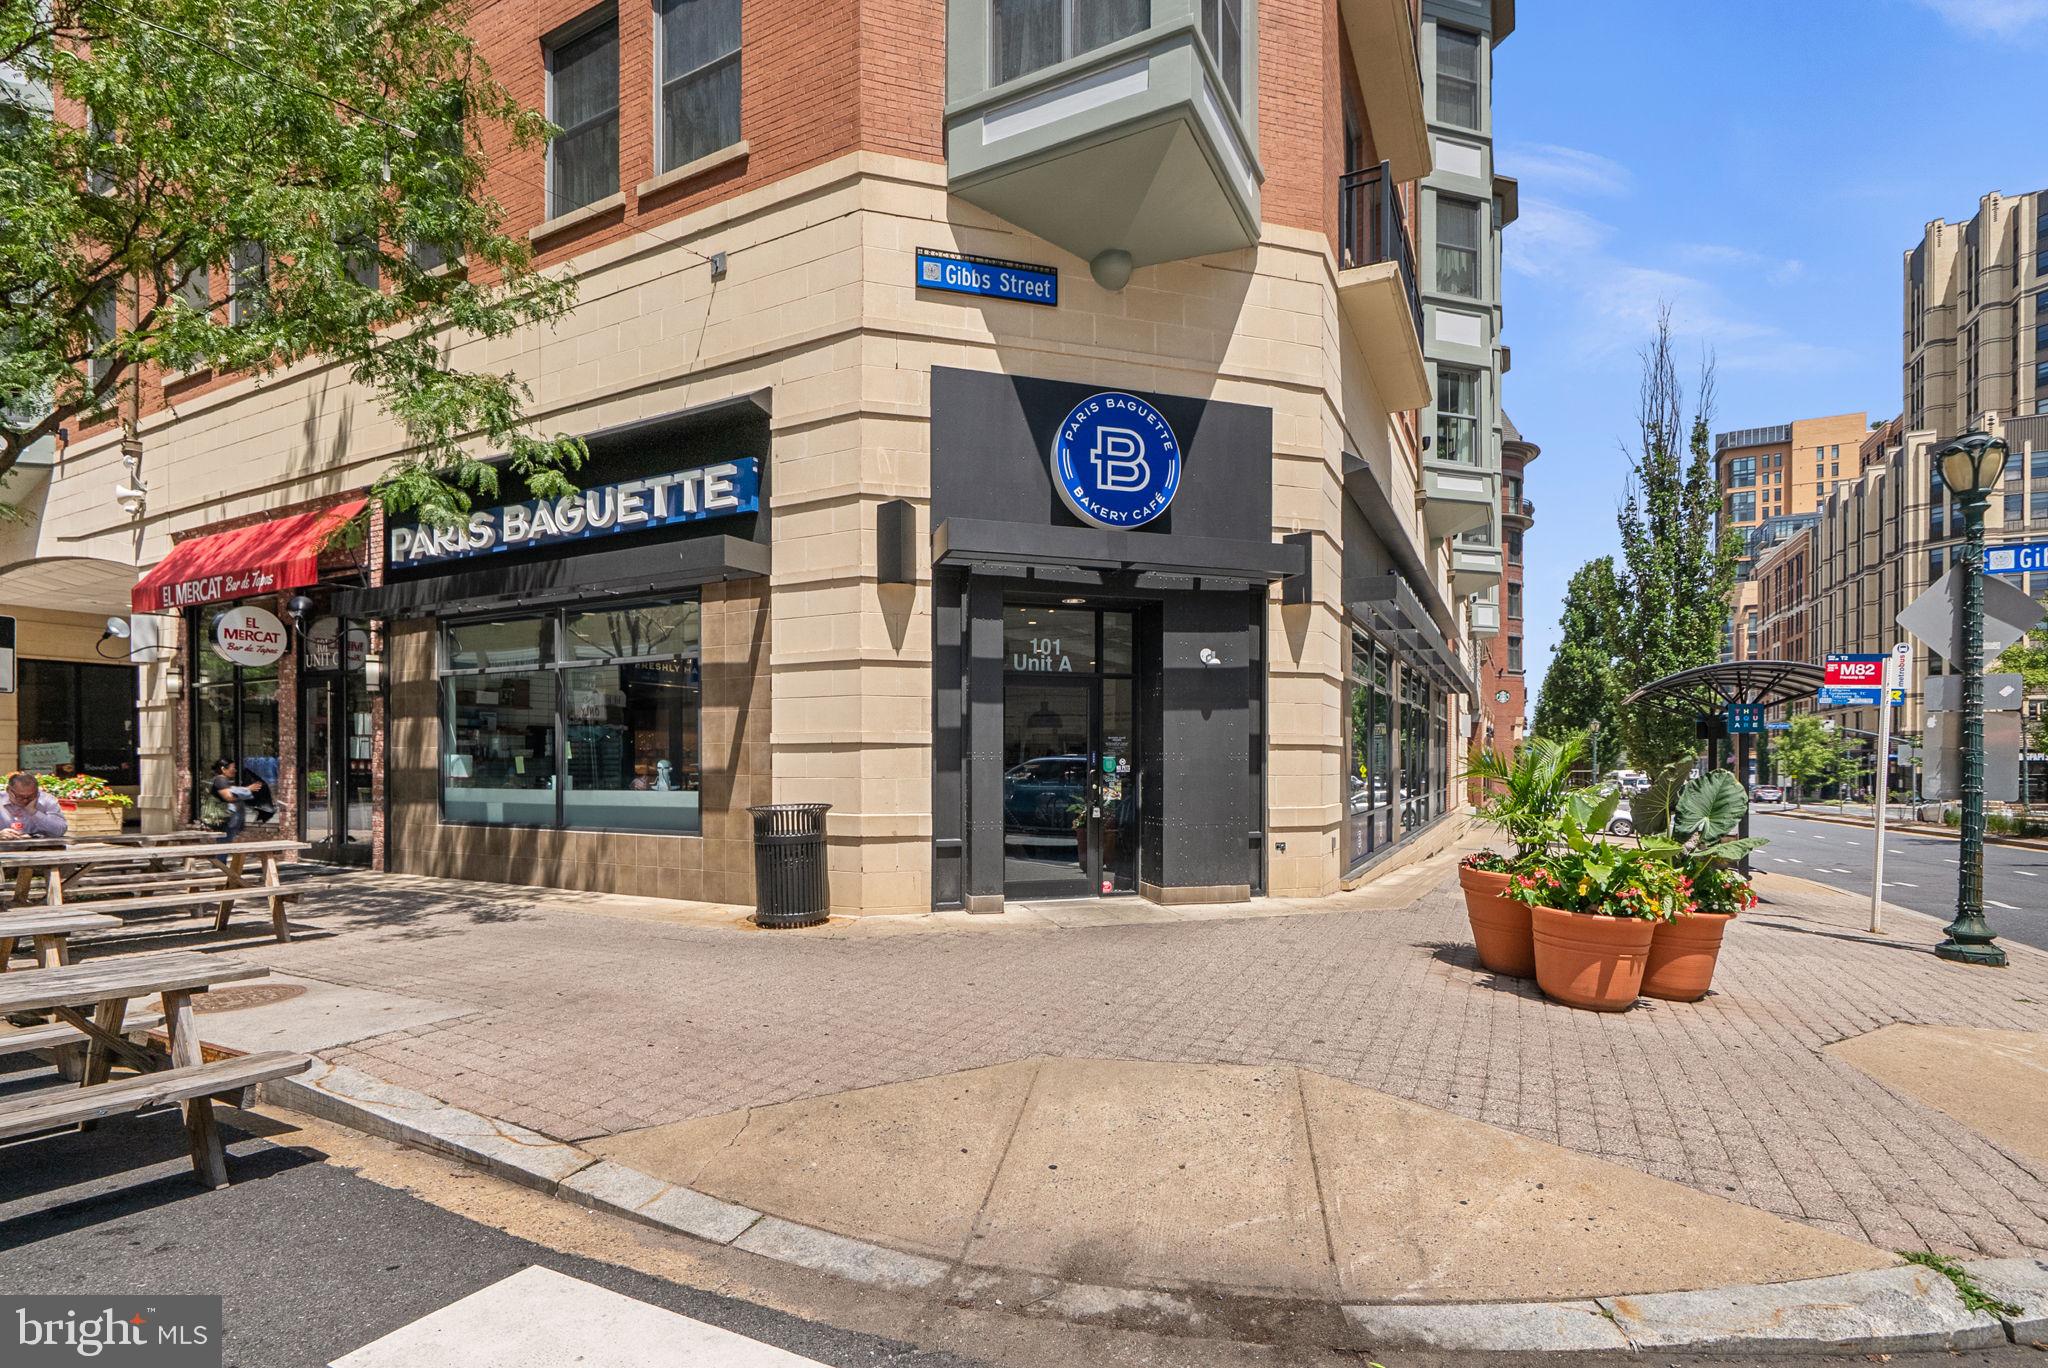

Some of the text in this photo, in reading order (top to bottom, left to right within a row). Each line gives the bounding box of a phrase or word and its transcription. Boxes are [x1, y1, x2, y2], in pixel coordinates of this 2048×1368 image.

[945, 264, 1051, 298] Gibbs Street
[1065, 398, 1173, 452] PARIS BAGUETTE
[391, 463, 739, 562] PARIS BAGUETTE
[1073, 486, 1165, 521] BAKERY CAFÉ
[162, 569, 274, 607] EL MERCAT Bar de Tapas
[245, 616, 259, 629] EL
[223, 628, 281, 644] MERCAT
[226, 642, 278, 656] Bar de Tapas
[1029, 638, 1060, 656] 101
[305, 652, 331, 668] UNIT
[1013, 653, 1073, 672] Unit A
[1840, 663, 1876, 676] M82
[1898, 655, 1906, 688] metrobus
